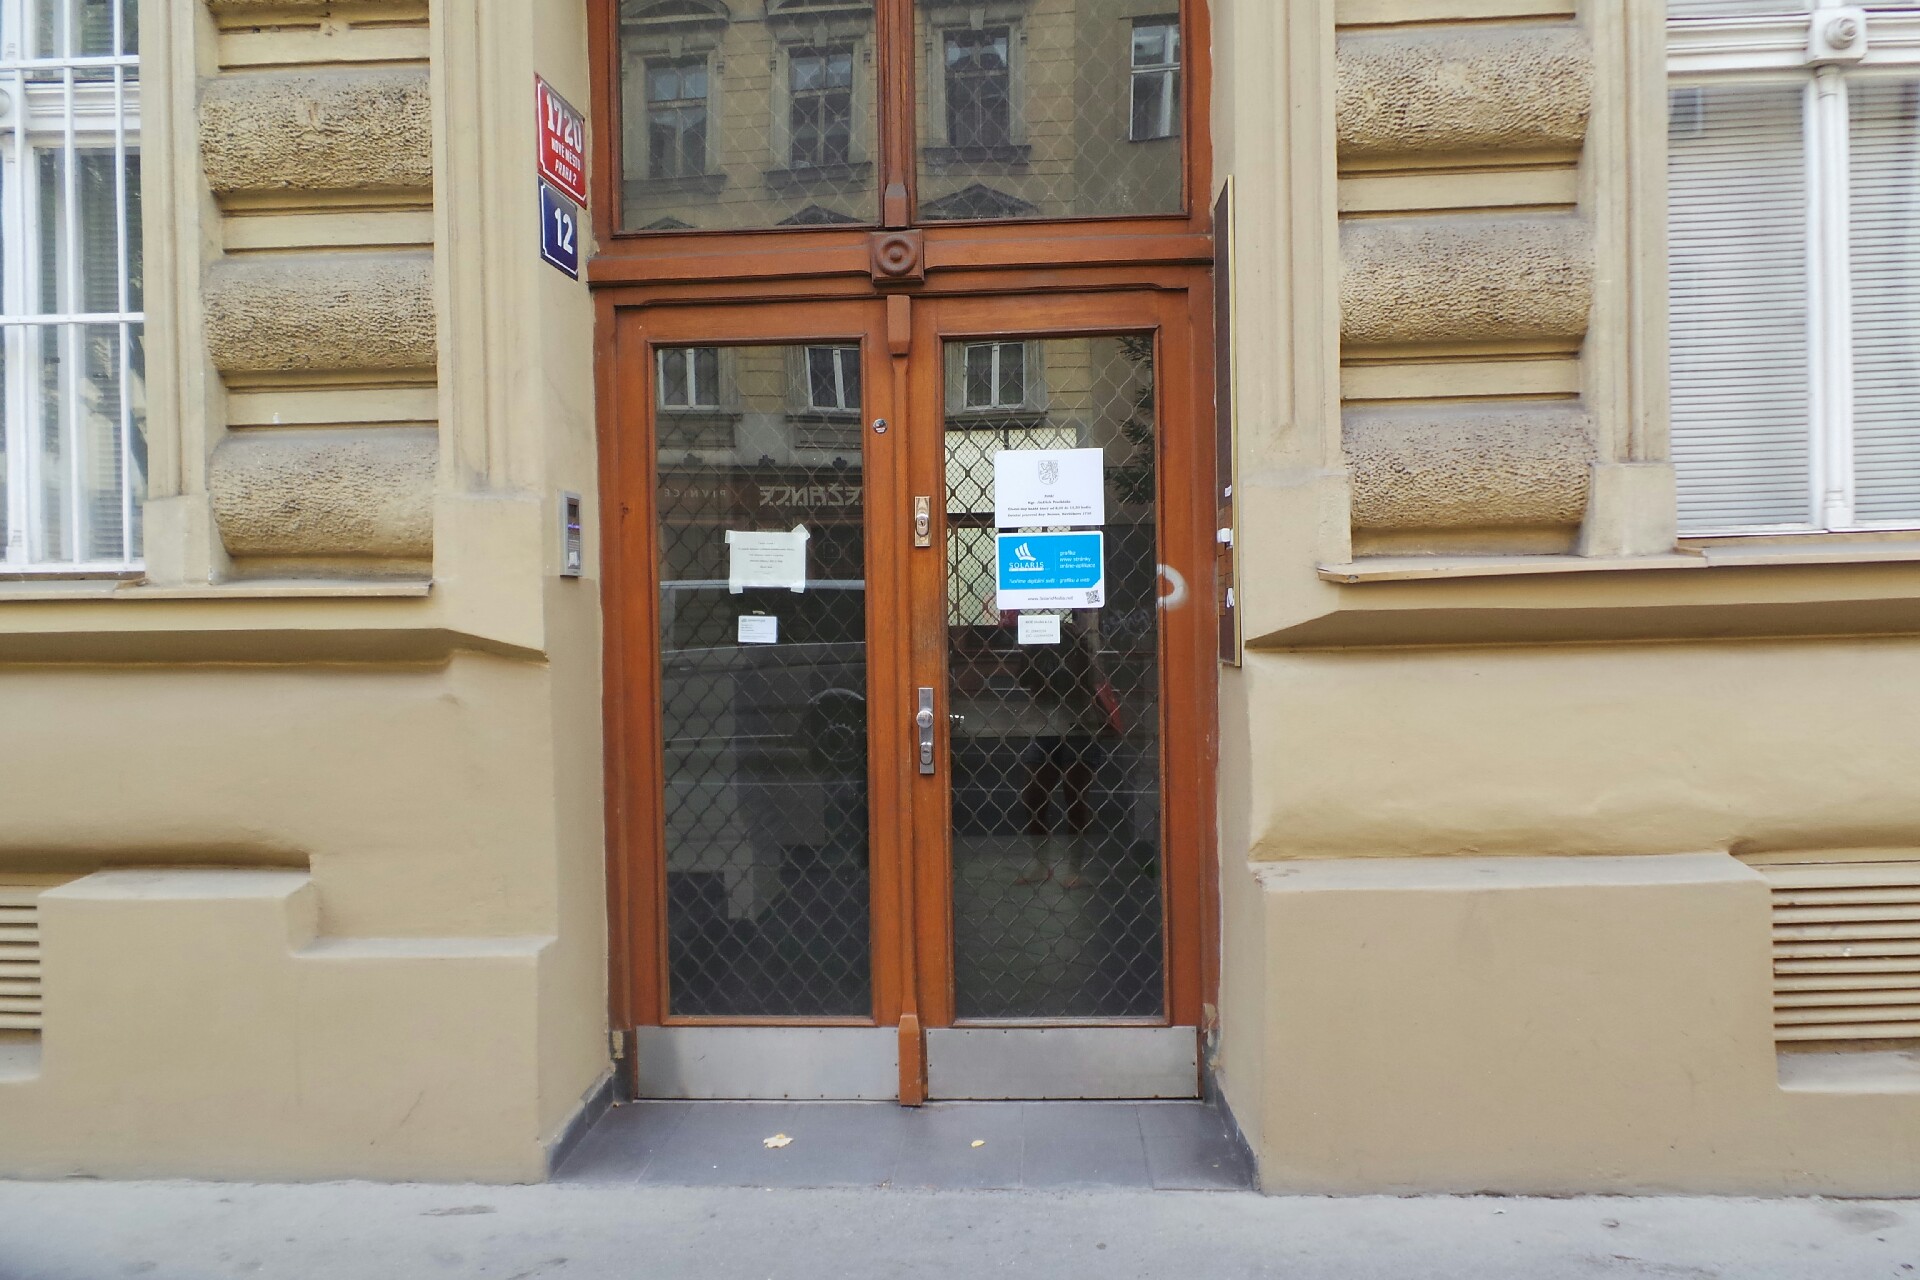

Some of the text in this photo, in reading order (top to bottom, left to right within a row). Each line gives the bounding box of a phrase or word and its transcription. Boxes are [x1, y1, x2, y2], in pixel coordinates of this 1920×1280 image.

[546, 93, 582, 154] 1720
[551, 137, 581, 172] NOVÉ MĚSTO
[554, 158, 577, 186] PRAHA 2
[554, 207, 574, 255] 12
